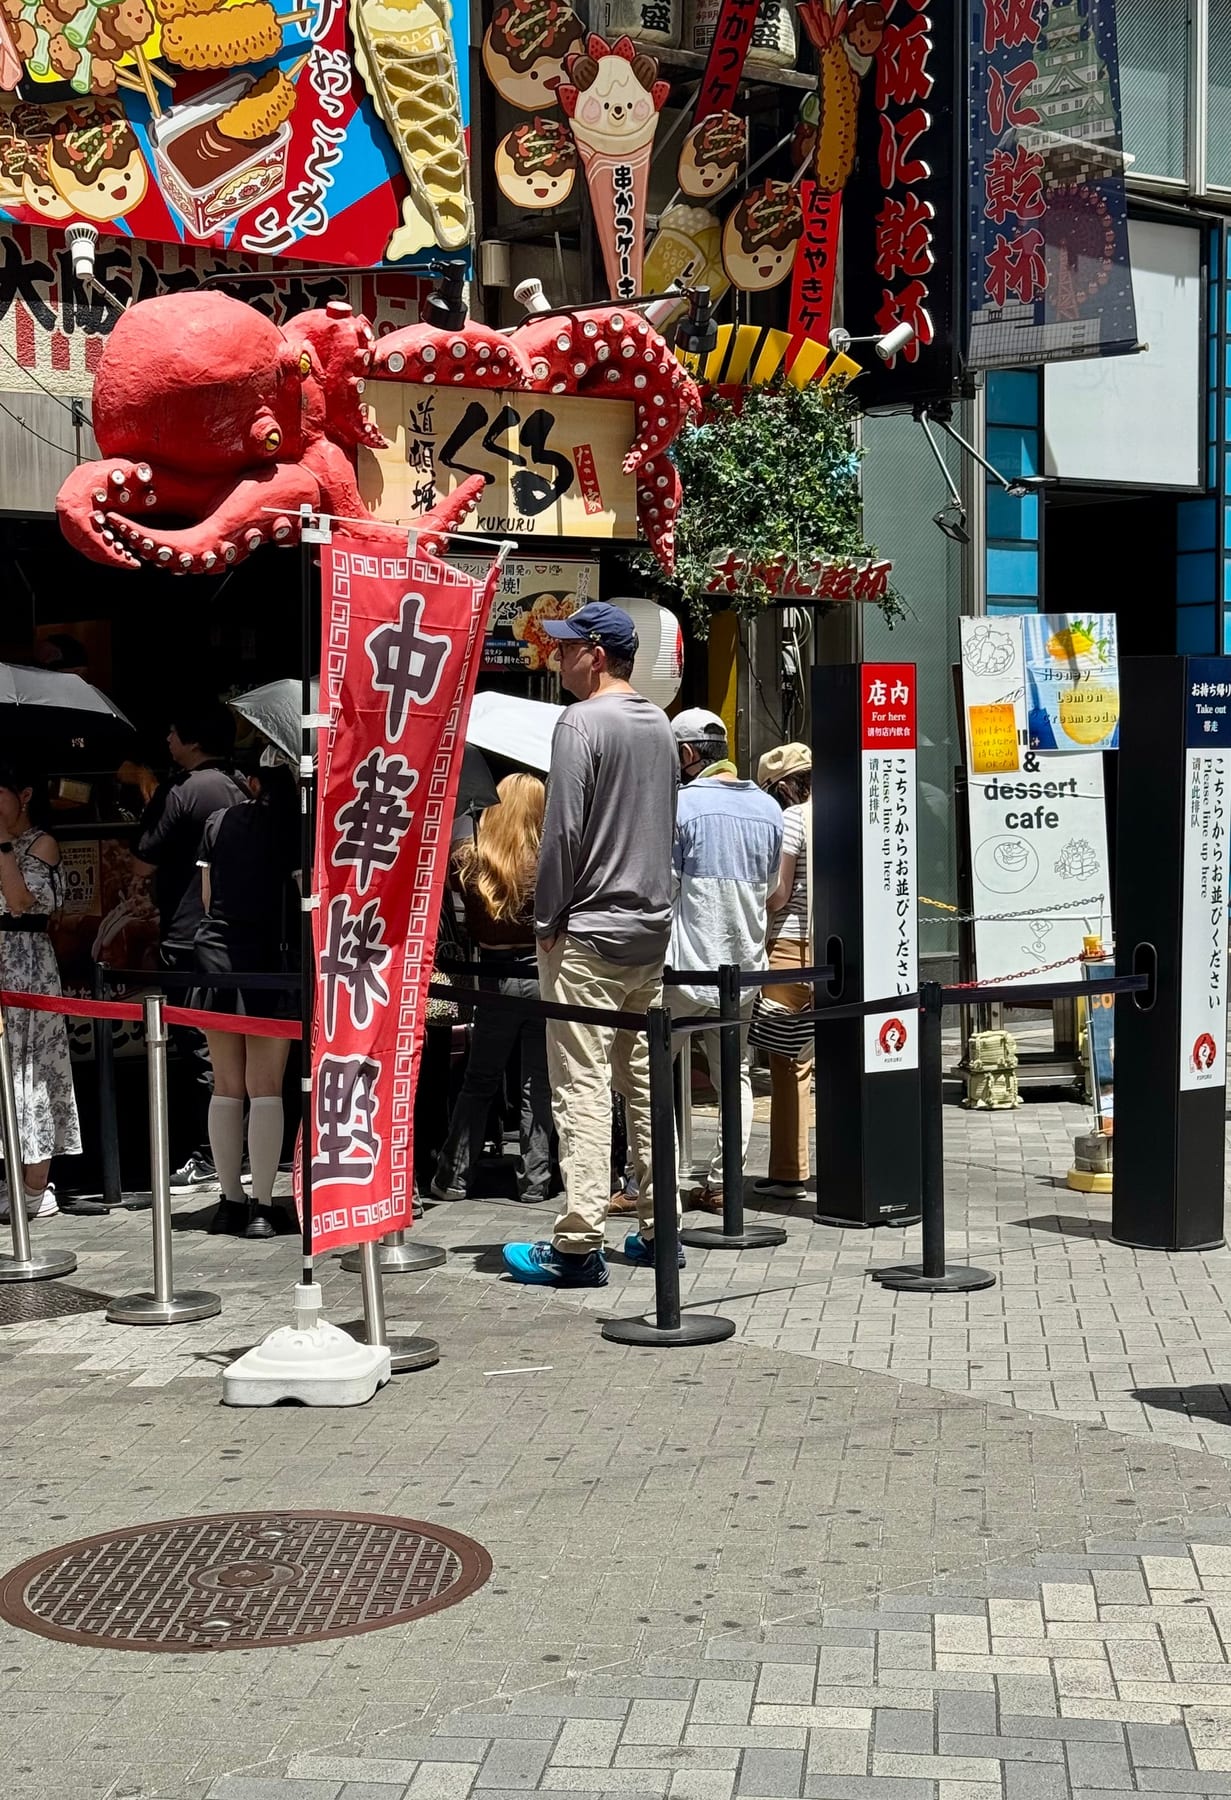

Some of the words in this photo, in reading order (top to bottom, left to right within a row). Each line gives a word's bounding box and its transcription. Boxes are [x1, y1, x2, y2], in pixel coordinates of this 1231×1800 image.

[875, 0, 935, 370] 阪に乾杯
[613, 164, 634, 299] 串かつケーキ
[409, 394, 438, 516] 道頓堀
[438, 401, 575, 516] くくる
[476, 516, 536, 532] KUKURU
[1044, 669, 1091, 682] Honey
[867, 680, 909, 706] 店内
[1056, 692, 1103, 703] Lemon
[872, 712, 886, 721] For
[888, 712, 907, 721] here
[1196, 704, 1213, 714] Take
[1214, 705, 1227, 714] out
[1023, 751, 1040, 772] &
[882, 759, 892, 804] Please
[984, 778, 1077, 800] dessert
[1203, 759, 1212, 805] Please
[883, 808, 893, 834] line
[1005, 806, 1059, 829] cafe
[1202, 809, 1211, 837] line
[882, 838, 891, 856] up
[1201, 842, 1208, 861] up
[883, 861, 892, 892] here
[894, 758, 910, 996] こちらからお並びください
[1200, 866, 1210, 898] here
[1208, 758, 1225, 1008] こちらからお並びください
